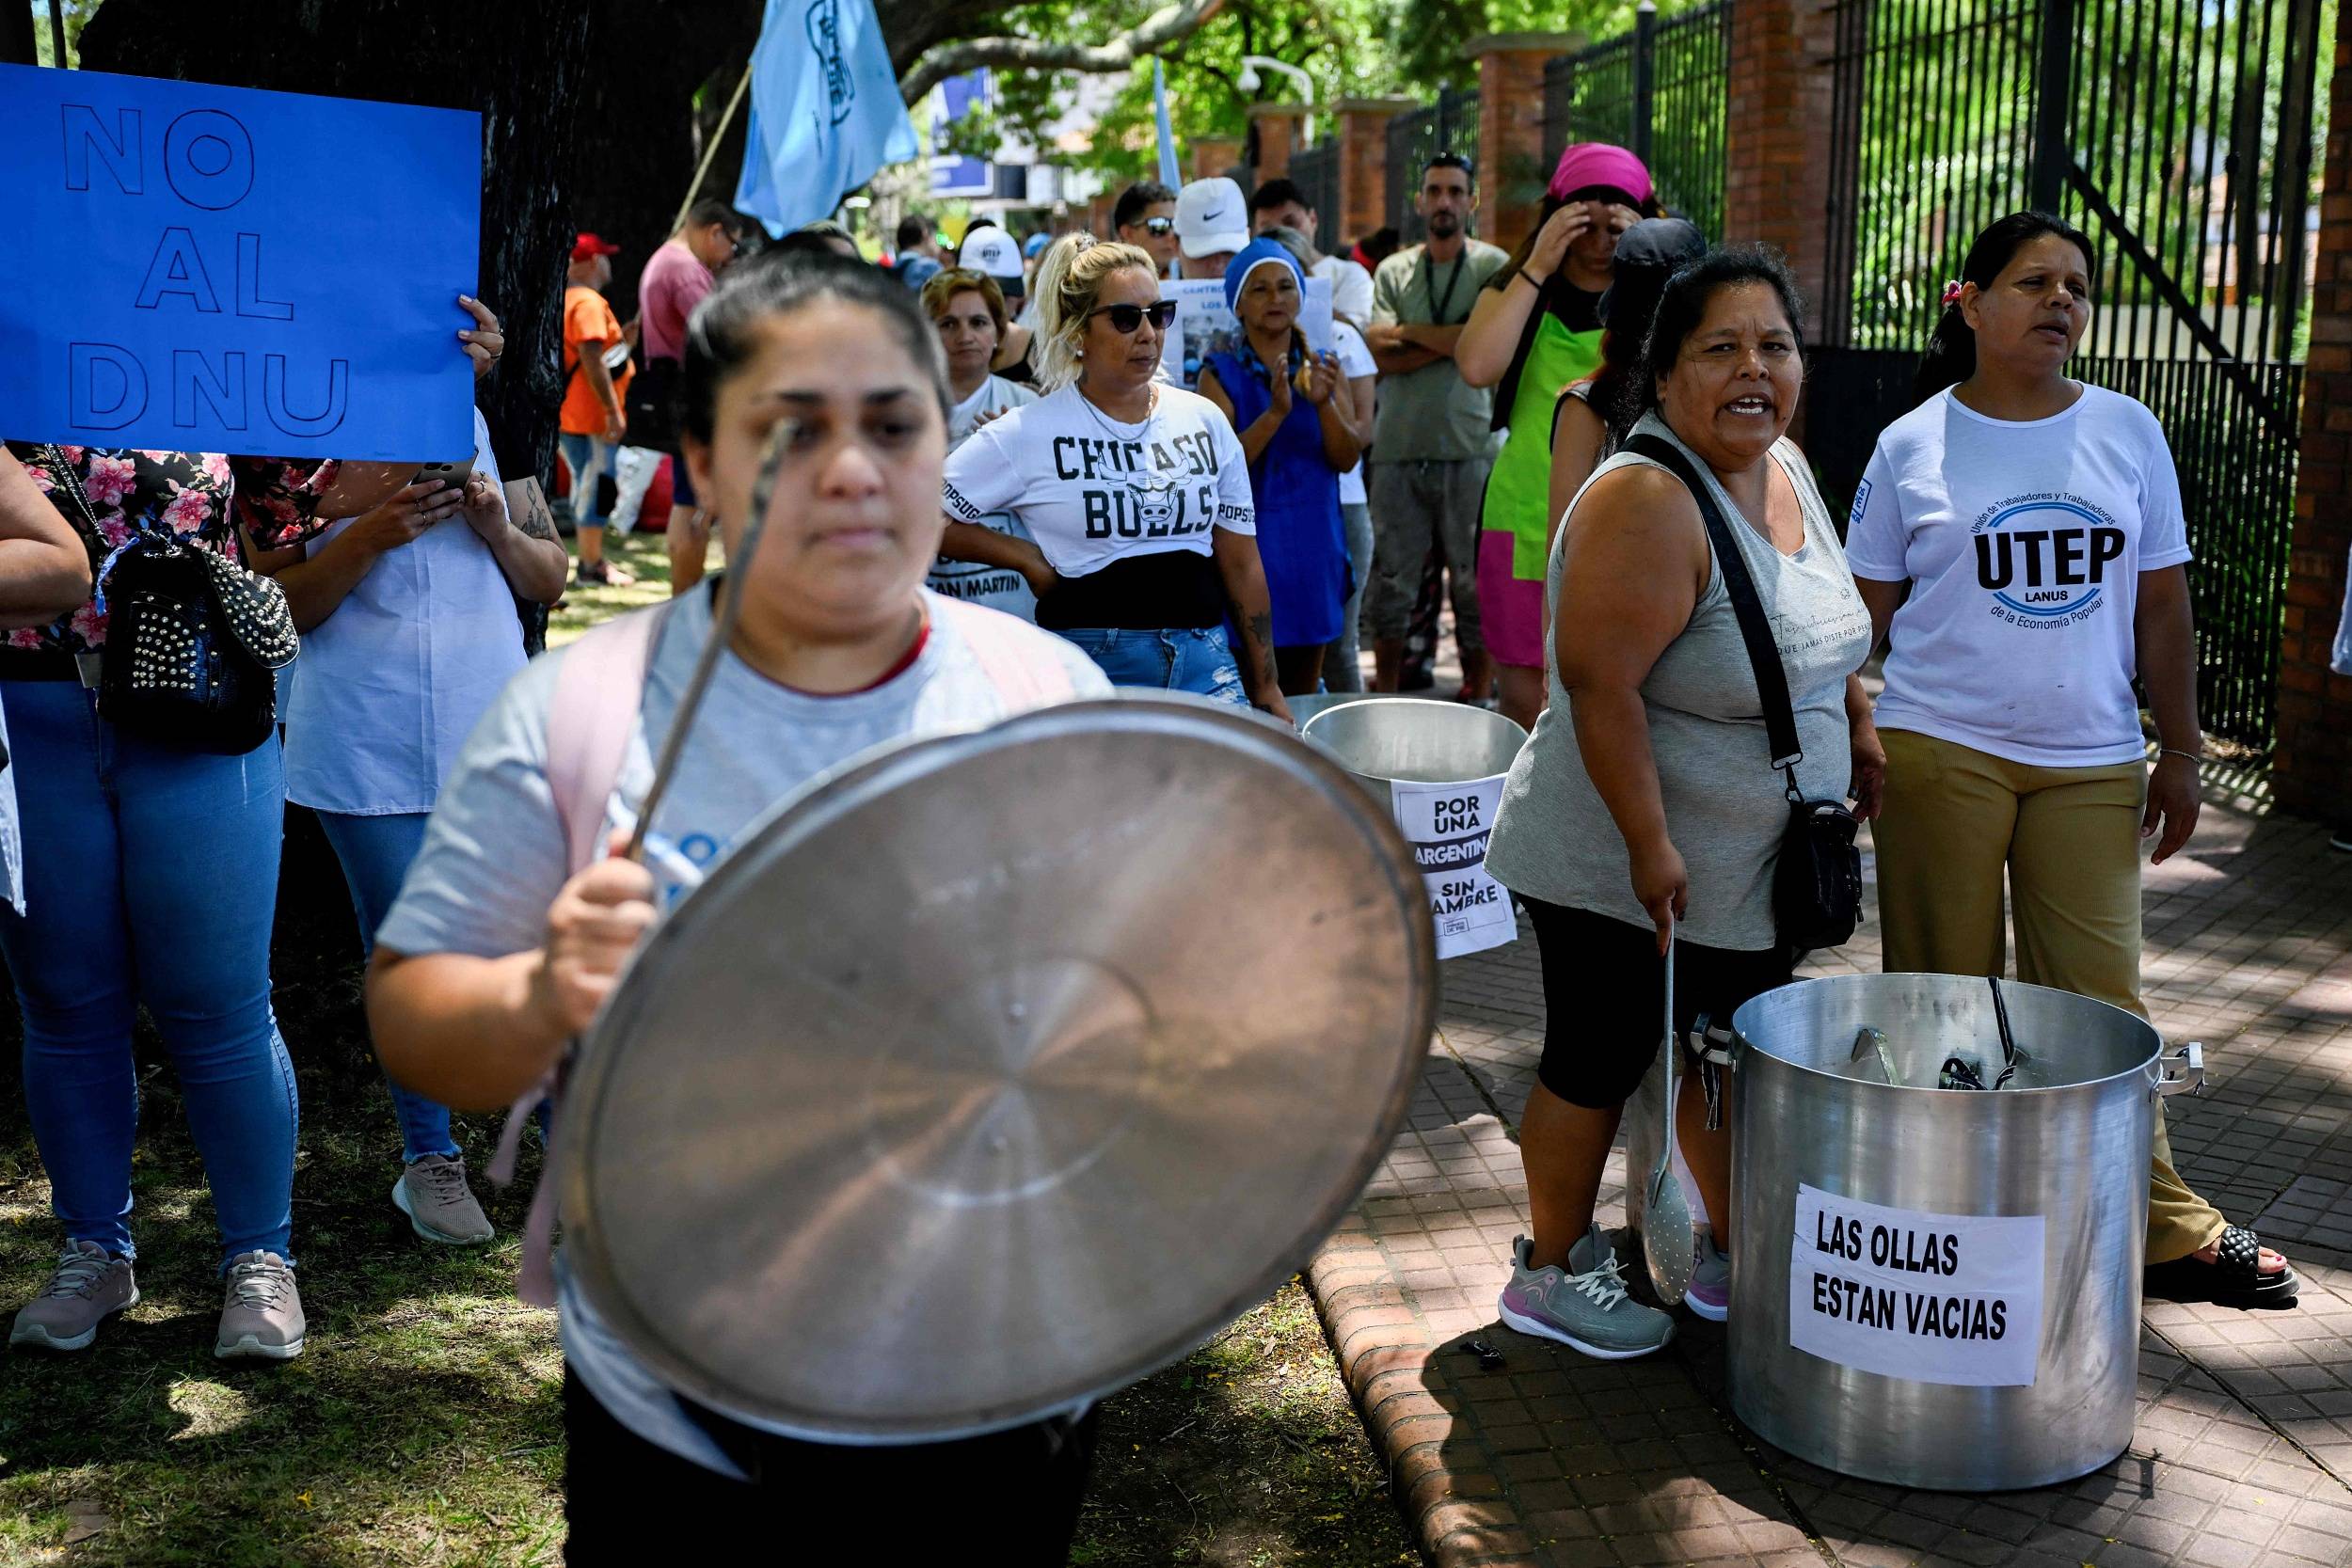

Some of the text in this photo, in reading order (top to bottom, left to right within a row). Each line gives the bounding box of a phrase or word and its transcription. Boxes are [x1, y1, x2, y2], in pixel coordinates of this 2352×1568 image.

[61, 103, 254, 211] NO
[135, 226, 294, 322] AL
[70, 341, 349, 438] DNU
[1053, 431, 1219, 481] CHICAGO
[1970, 492, 2116, 534] Unión de Trabajadores y Trabajadoras
[1973, 527, 2126, 591] UTEP
[927, 574, 1021, 597] AN MARTIN
[2025, 590, 2069, 603] LANUS
[1991, 596, 2104, 630] de la Economía Popular
[1434, 796, 1480, 817] POR
[1434, 813, 1480, 834] UNA
[1415, 836, 1486, 865] ARGENTIN
[1432, 884, 1498, 915] AMBRE
[1441, 879, 1475, 897] SIN
[1816, 1210, 1959, 1276] LAS OLLAS
[1813, 1272, 2007, 1340] ESTAN VACIAS
